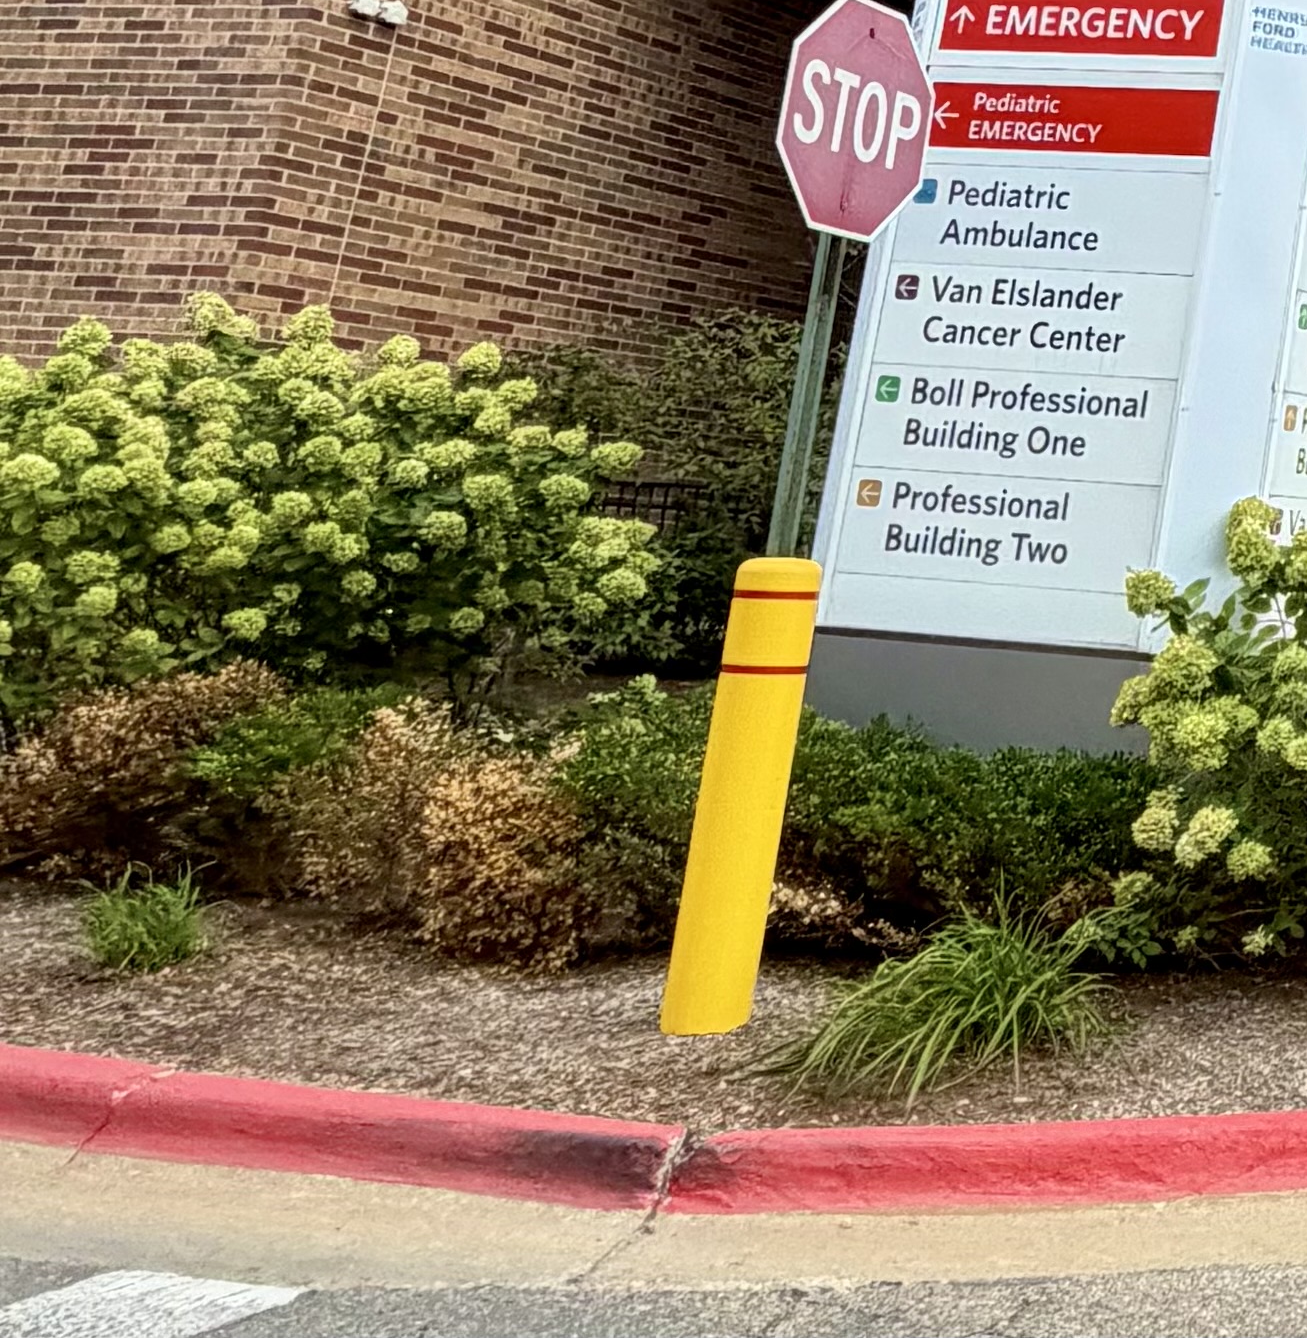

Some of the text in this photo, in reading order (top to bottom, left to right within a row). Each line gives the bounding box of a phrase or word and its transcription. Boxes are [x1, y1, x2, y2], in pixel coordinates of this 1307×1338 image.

[985, 4, 1204, 40] EMERGENCY
[1252, 21, 1296, 38] FORD
[793, 59, 921, 170] STOP
[973, 92, 1061, 114] Pediatric
[968, 120, 1103, 143] EMERGENCY
[948, 180, 1070, 210] Pediatric
[939, 219, 1099, 251] Ambulance
[932, 276, 1123, 311] Van Elslander
[923, 316, 1126, 353] Cancer Center
[911, 377, 1148, 418] Boll Professional
[903, 418, 1086, 458] Building One
[892, 482, 1070, 521] Professional
[885, 524, 1068, 566] Building Two
